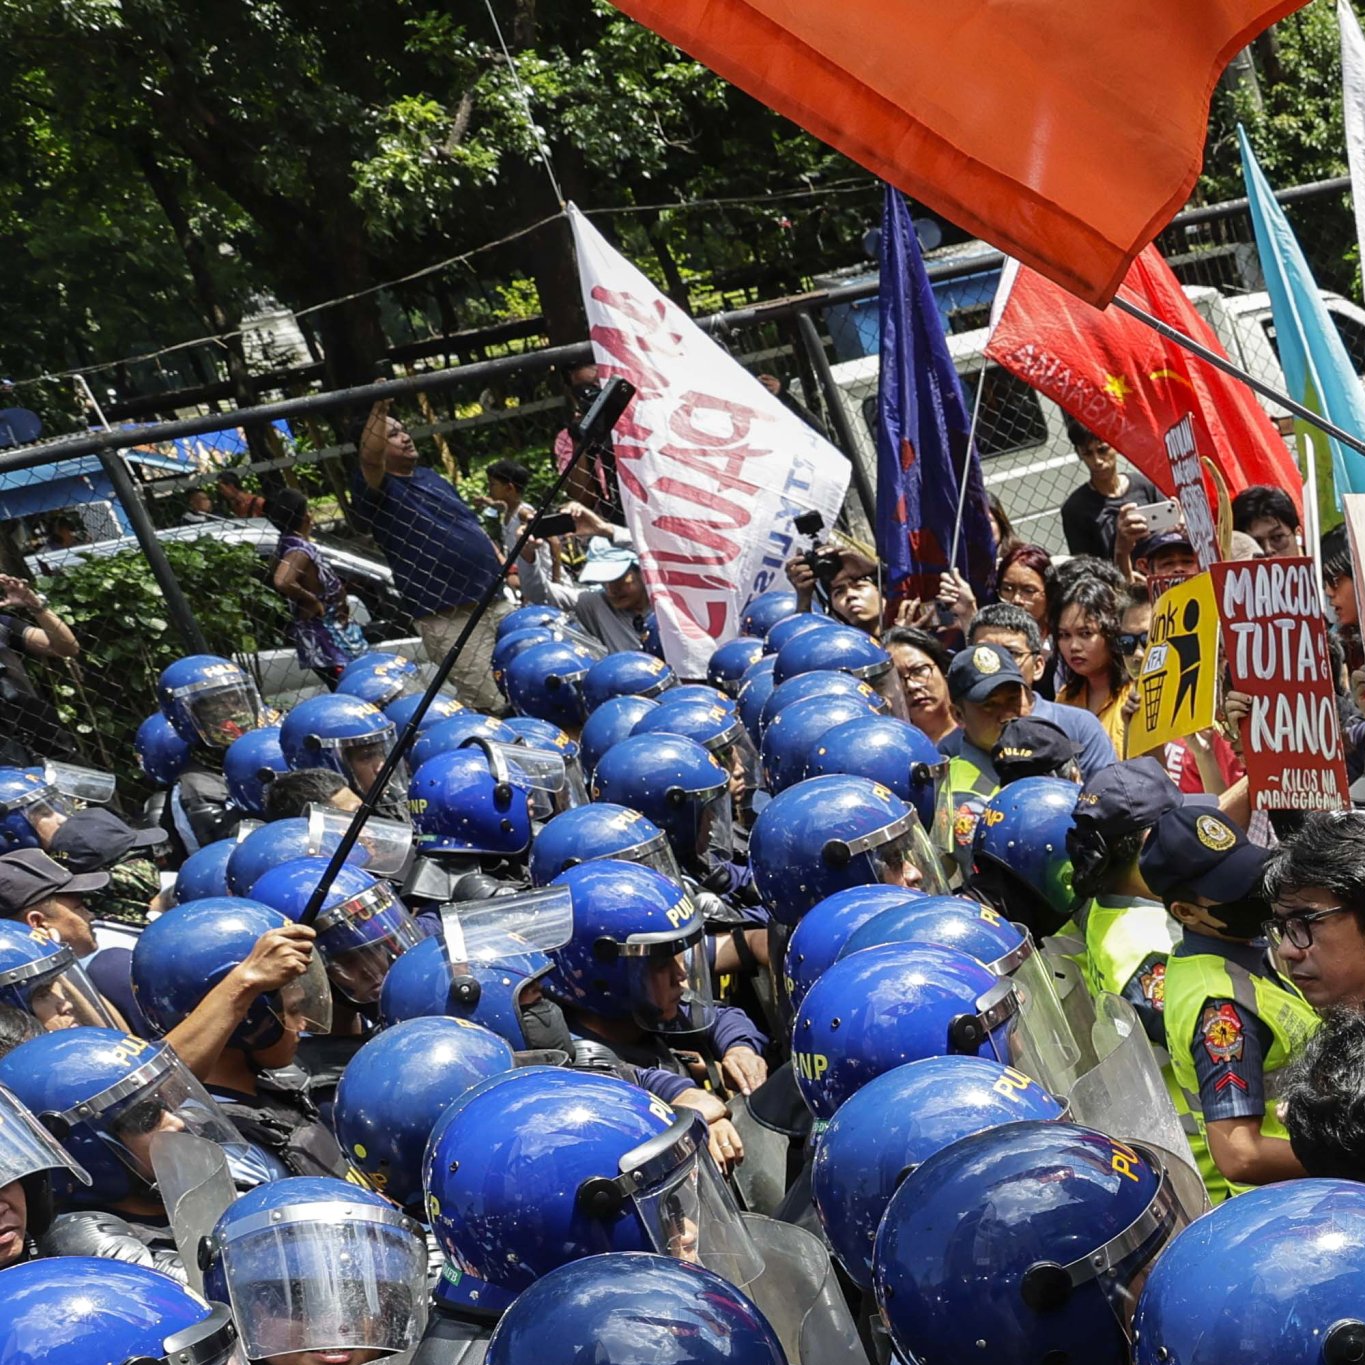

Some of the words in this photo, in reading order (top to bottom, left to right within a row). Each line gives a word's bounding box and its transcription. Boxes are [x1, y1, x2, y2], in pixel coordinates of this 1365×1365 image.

[1222, 562, 1325, 620] MARCOS
[1229, 618, 1315, 682] TUTA
[1321, 768, 1337, 793] NA
